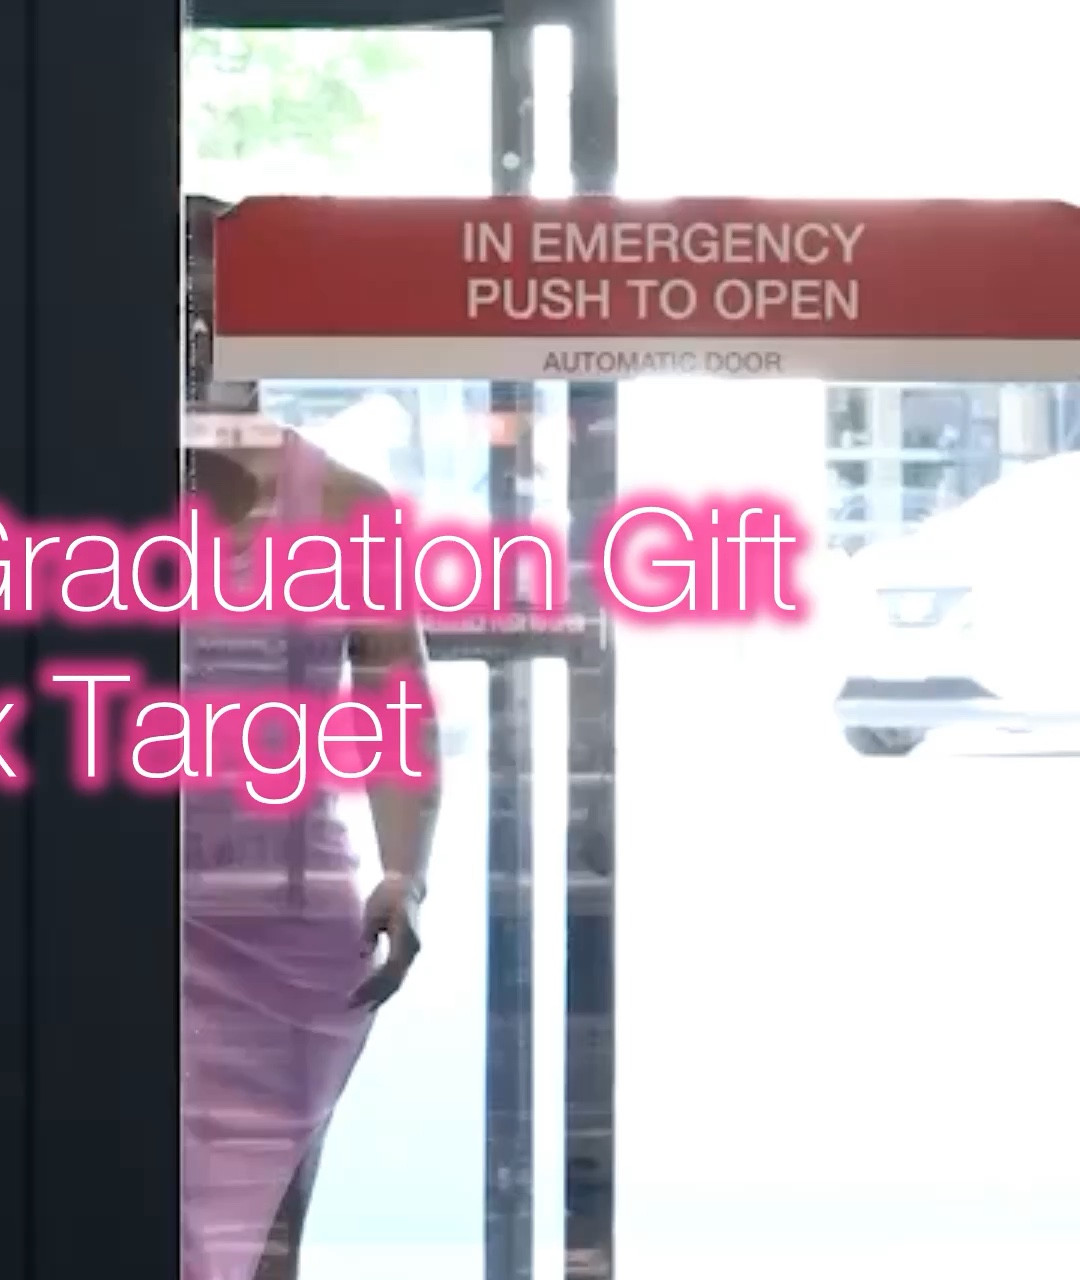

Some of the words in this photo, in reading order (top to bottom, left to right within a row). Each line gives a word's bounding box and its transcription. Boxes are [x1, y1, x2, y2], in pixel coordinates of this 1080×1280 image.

[463, 221, 513, 263] IN
[532, 221, 865, 265] EMERGENCY
[467, 278, 611, 320] PUSH
[626, 278, 697, 320] TO
[713, 278, 859, 320] OPEN
[543, 351, 697, 374] AUTOMATIC
[704, 351, 783, 374] DOOR
